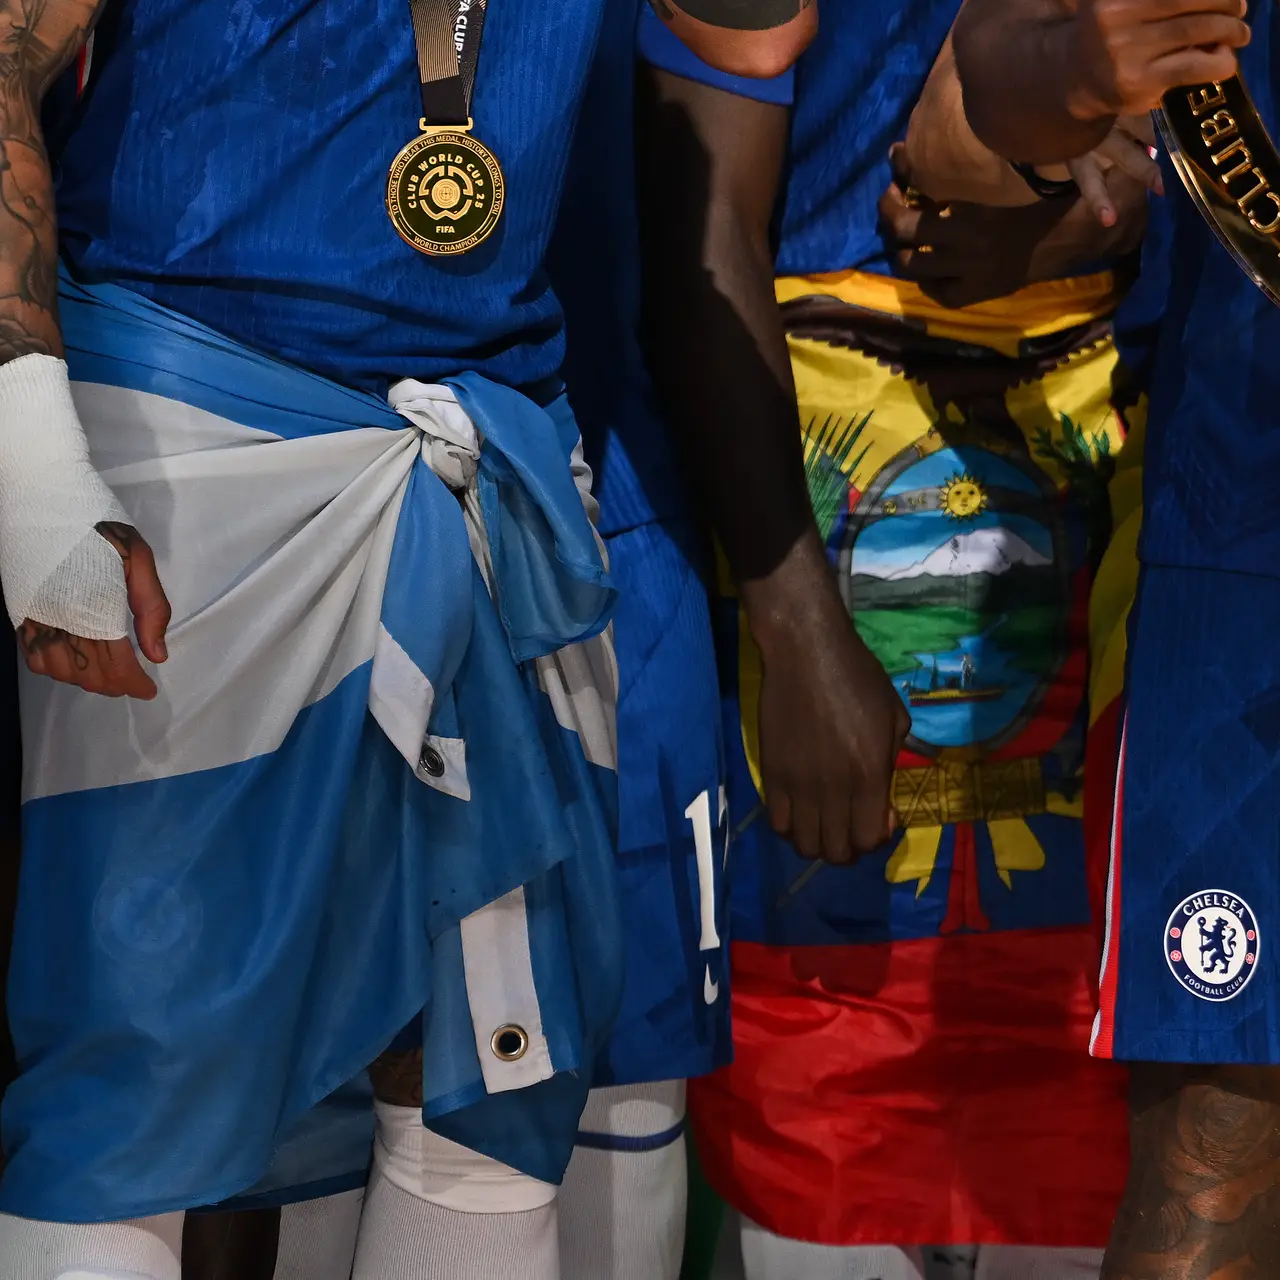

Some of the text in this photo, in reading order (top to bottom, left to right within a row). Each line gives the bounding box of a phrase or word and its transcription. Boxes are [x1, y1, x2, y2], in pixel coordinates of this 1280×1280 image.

[390, 135, 502, 216] TO THOSE WHO WEAR THIS MEDAL, HISTORY BELONGS TO YOU
[407, 153, 485, 209] CLUB WORLD CUP 25
[435, 225, 455, 234] FIFA
[414, 235, 478, 252] WORLD CHAMPION
[1182, 894, 1246, 918] CHELSEA
[1183, 973, 1244, 996] FOOTBALL CLUB
